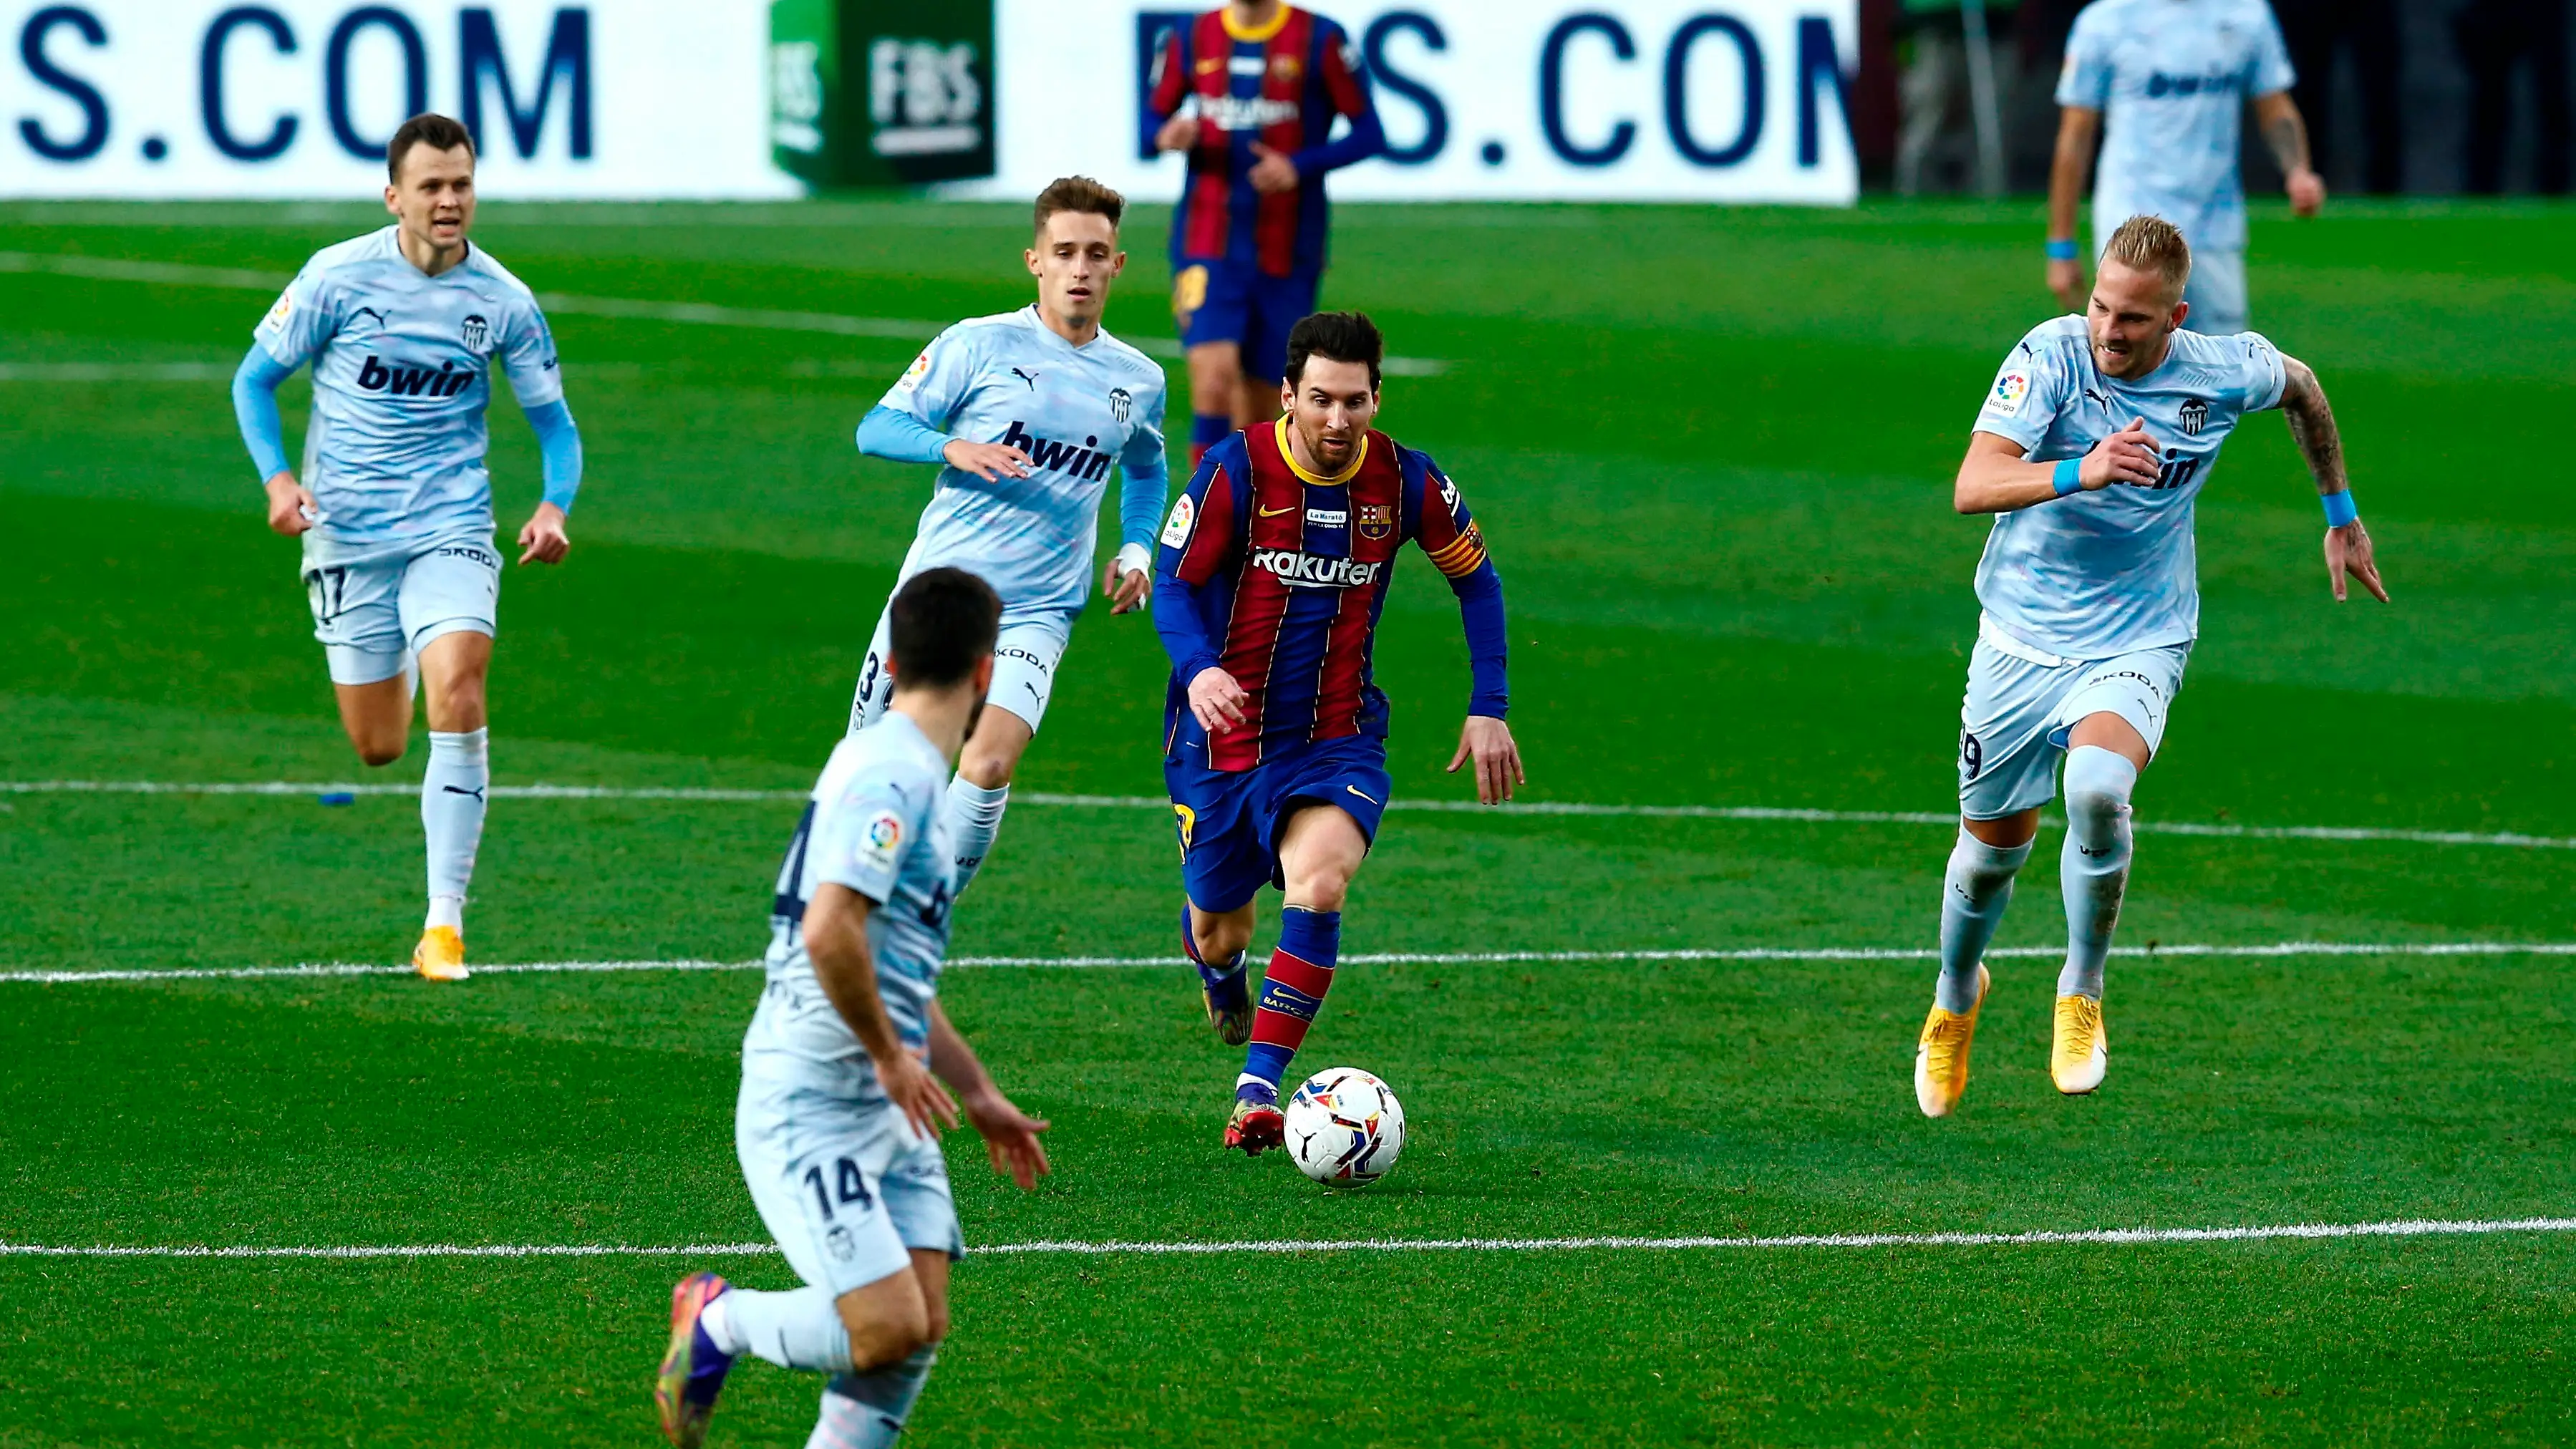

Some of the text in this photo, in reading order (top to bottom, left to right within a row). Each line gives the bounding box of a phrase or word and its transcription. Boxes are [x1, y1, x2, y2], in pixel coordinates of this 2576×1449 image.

[871, 38, 979, 123] FBS
[1989, 398, 2015, 412] LaLiga
[804, 1157, 873, 1221] 14
